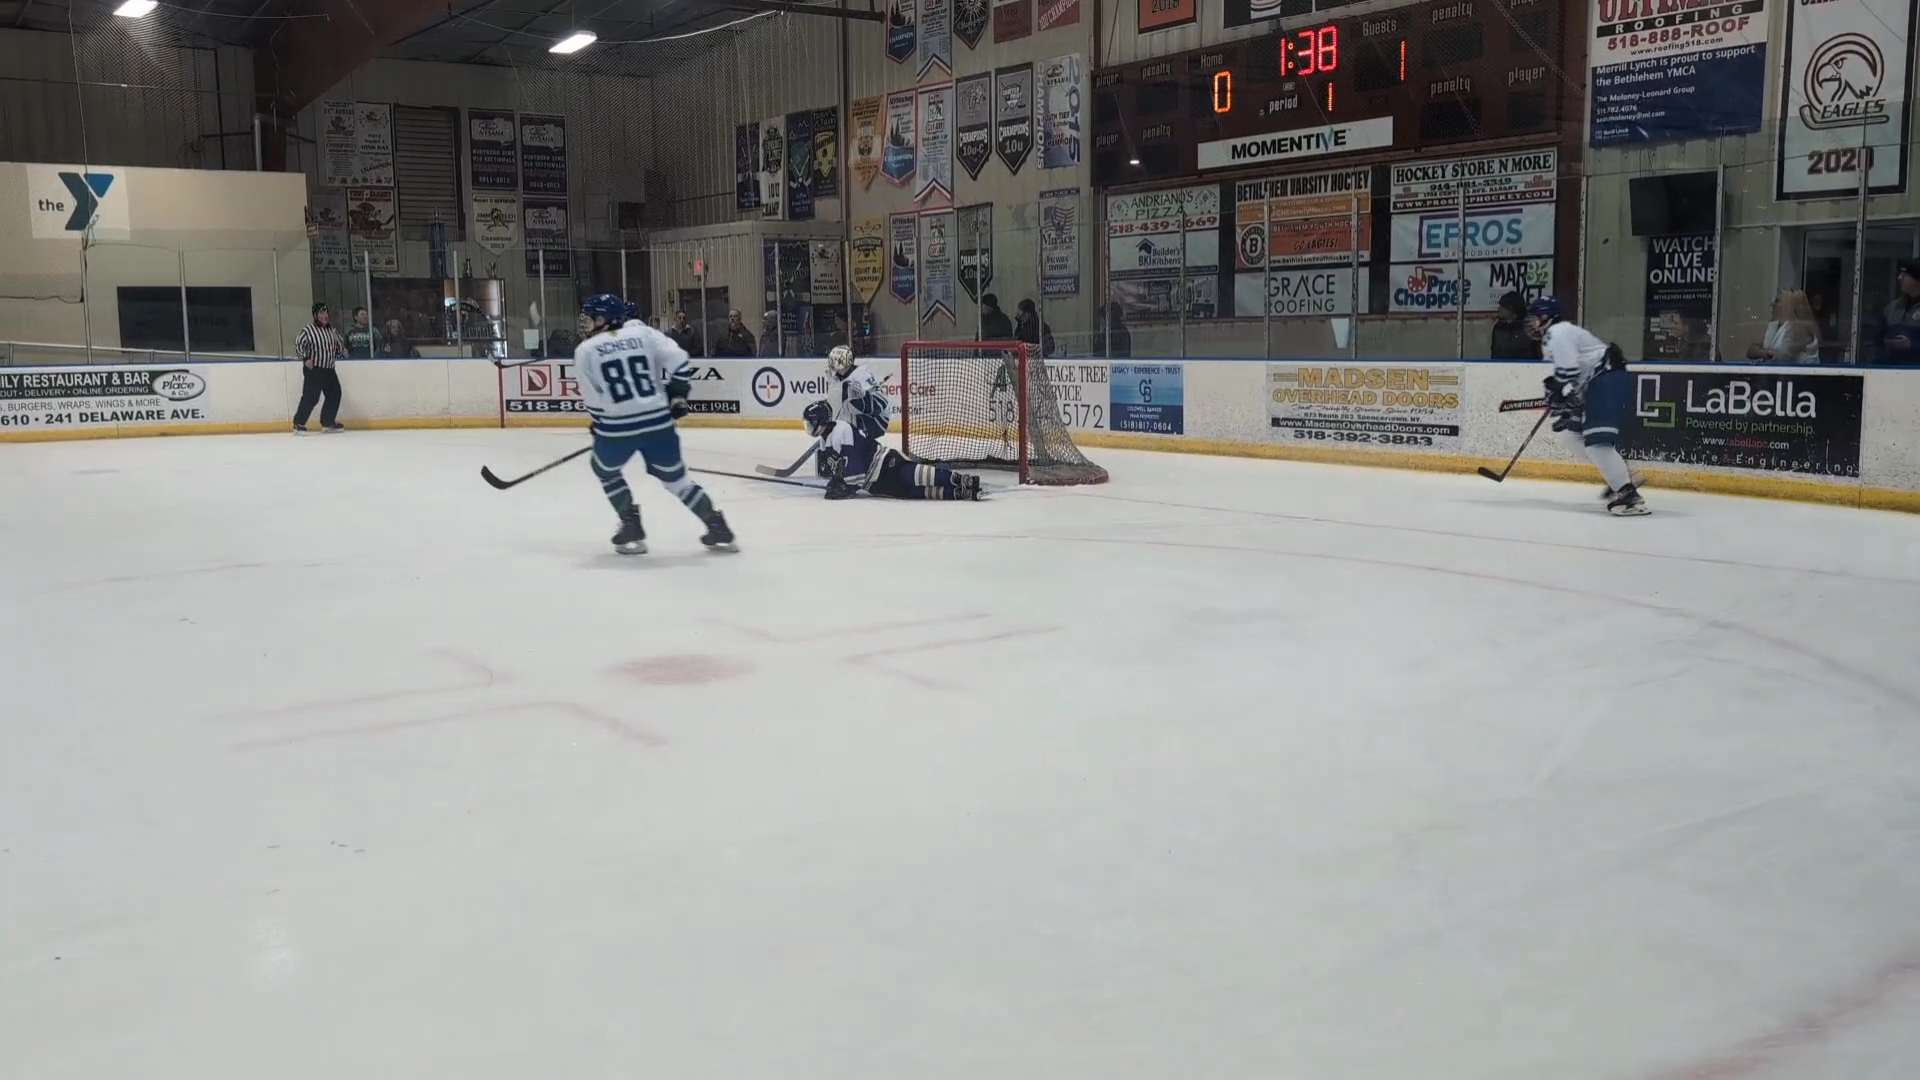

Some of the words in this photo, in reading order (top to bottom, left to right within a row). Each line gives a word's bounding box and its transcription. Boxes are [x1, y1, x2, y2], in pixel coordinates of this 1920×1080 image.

[1152, 0, 1180, 13] 2018
[1432, 2, 1472, 24] penalty
[1362, 19, 1397, 36] Guests
[1615, 4, 1743, 34] ROOFING
[1607, 16, 1751, 50] 518-888-ROOF
[1280, 25, 1339, 77] 1:38
[1630, 37, 1724, 56] www.roofing518.com
[1200, 54, 1223, 69] Home
[1596, 61, 1628, 75] Merrill
[1630, 59, 1657, 73] Lynch
[1659, 57, 1669, 67] is
[1670, 51, 1699, 67] proud
[1702, 51, 1713, 61] to
[1715, 45, 1756, 60] support
[1096, 72, 1119, 88] player
[1142, 63, 1171, 80] penalty
[1508, 66, 1546, 87] player
[1596, 77, 1612, 88] the
[1614, 71, 1664, 86] Bethlehem
[1666, 65, 1697, 78] YMCA
[1214, 71, 1231, 113] 0
[1430, 77, 1472, 98] penalty
[1609, 88, 1671, 102] Moloney-Leonard
[1673, 86, 1696, 96] Group
[1269, 94, 1298, 114] period
[1820, 99, 1887, 119] EAGLES
[1036, 62, 1045, 170] CHAMPIONS
[999, 121, 1029, 142] CHAMPIONS
[1096, 133, 1119, 147] player
[1142, 124, 1171, 141] penalty
[1004, 140, 1023, 154] 10u
[1231, 126, 1347, 160] MOMENTIVE
[1395, 164, 1449, 183] HOCKEY
[1452, 160, 1495, 178] STORE
[1498, 158, 1509, 173] N
[1510, 153, 1552, 171] MORE
[1290, 174, 1330, 197] VARSITY
[38, 198, 66, 212] the
[1131, 190, 1195, 209] ANDRIANO'S
[1135, 205, 1188, 221] PIZZA
[1309, 222, 1334, 231] YOUTH
[1334, 219, 1362, 229] HOCKY
[1426, 218, 1523, 249] EFROS
[1152, 247, 1180, 256] Builder's
[1249, 237, 1260, 254] B
[1293, 239, 1305, 251] GO
[1444, 247, 1523, 258] ORHODONTICS
[1652, 235, 1716, 254] WATCH
[1152, 256, 1181, 266] Kitchens
[1665, 252, 1703, 268] LIVE
[1427, 275, 1472, 293] Price
[1650, 267, 1716, 284] ONLINE
[1269, 274, 1336, 298] GRACE
[1393, 287, 1470, 309] Chopper
[171, 374, 188, 384] My
[601, 354, 656, 404] 86
[1046, 365, 1076, 383] TAGE
[1078, 366, 1108, 384] TREE
[1111, 366, 1128, 375] LEGACY
[1133, 366, 1160, 375] EXPERIENCE
[1165, 366, 1181, 375] TRUST
[1297, 367, 1431, 391] MADSEN
[0, 375, 20, 389] ILY
[23, 373, 108, 389] RESTAURANT
[112, 372, 120, 386] &
[124, 372, 151, 385] BAR
[162, 381, 195, 391] Place
[789, 377, 829, 395] well
[25, 388, 66, 397] DELIVERY
[73, 387, 103, 396] ONLINE
[105, 386, 149, 395] ORDERING
[1272, 388, 1378, 406] OVERHEAD
[1382, 391, 1459, 409] DOORS
[1686, 379, 1817, 418] LaBella
[8, 402, 56, 412] BURGERS,
[58, 401, 93, 411] WRAPS,
[96, 400, 124, 409] WINGS
[127, 399, 134, 407] &
[136, 398, 161, 407] MORE
[688, 403, 708, 412] NCE
[710, 402, 738, 412] 1984
[45, 413, 72, 425] 241
[79, 410, 166, 424] DELAWARE
[170, 409, 205, 420] AVE.
[1062, 403, 1105, 429] 5172
[1119, 421, 1173, 432] (518)817-0604
[1279, 419, 1451, 436] www.MadsenOverheadDoors.com
[1685, 417, 1732, 433] Powered
[1734, 418, 1749, 433] by
[1750, 421, 1814, 438] partnership.
[1294, 429, 1434, 447] 518-392-3883
[1701, 436, 1790, 451] www.labellapc.com
[1620, 448, 1718, 464] chitecture
[1735, 454, 1855, 477] Engineering
